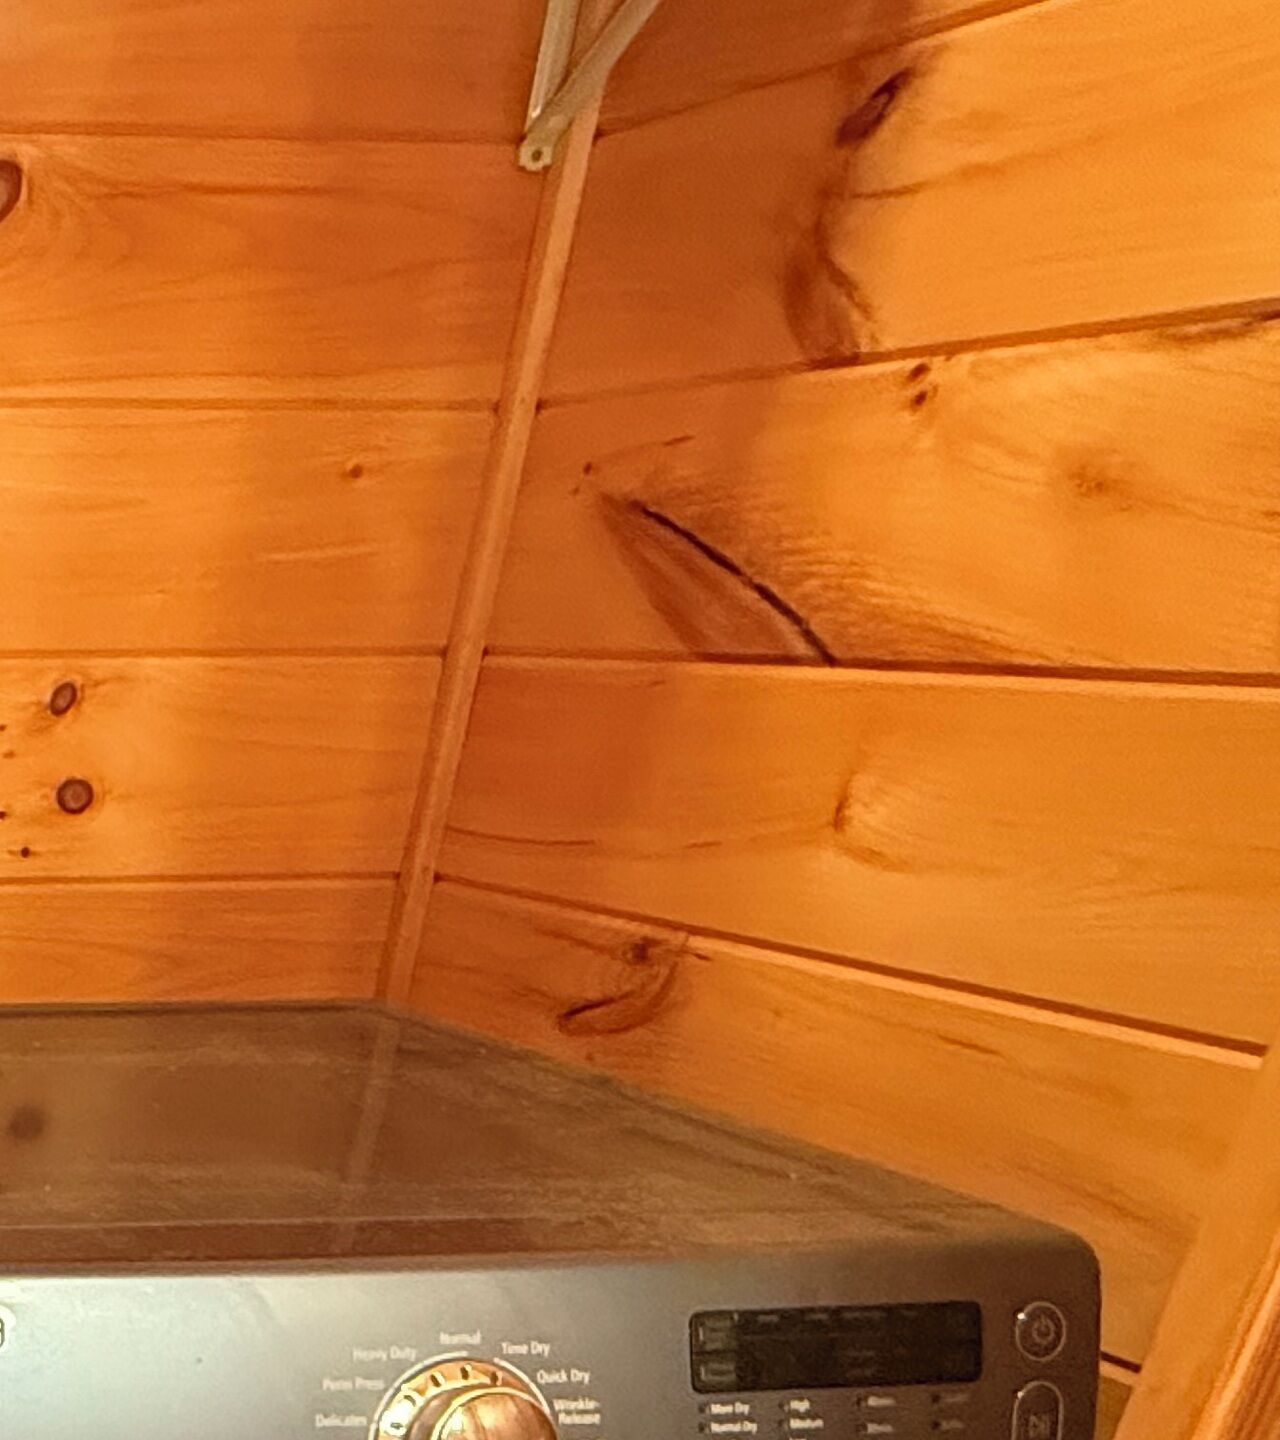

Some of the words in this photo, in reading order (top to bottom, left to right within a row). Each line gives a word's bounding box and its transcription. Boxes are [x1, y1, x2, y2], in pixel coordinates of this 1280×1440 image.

[440, 1330, 482, 1345] Normal
[352, 1348, 388, 1363] Heavy
[390, 1345, 417, 1362] Duty
[501, 1342, 529, 1355] Time
[530, 1340, 551, 1357] Dry
[536, 1369, 568, 1385] Quick
[570, 1367, 591, 1385] Dry
[314, 1412, 368, 1428] Delicates
